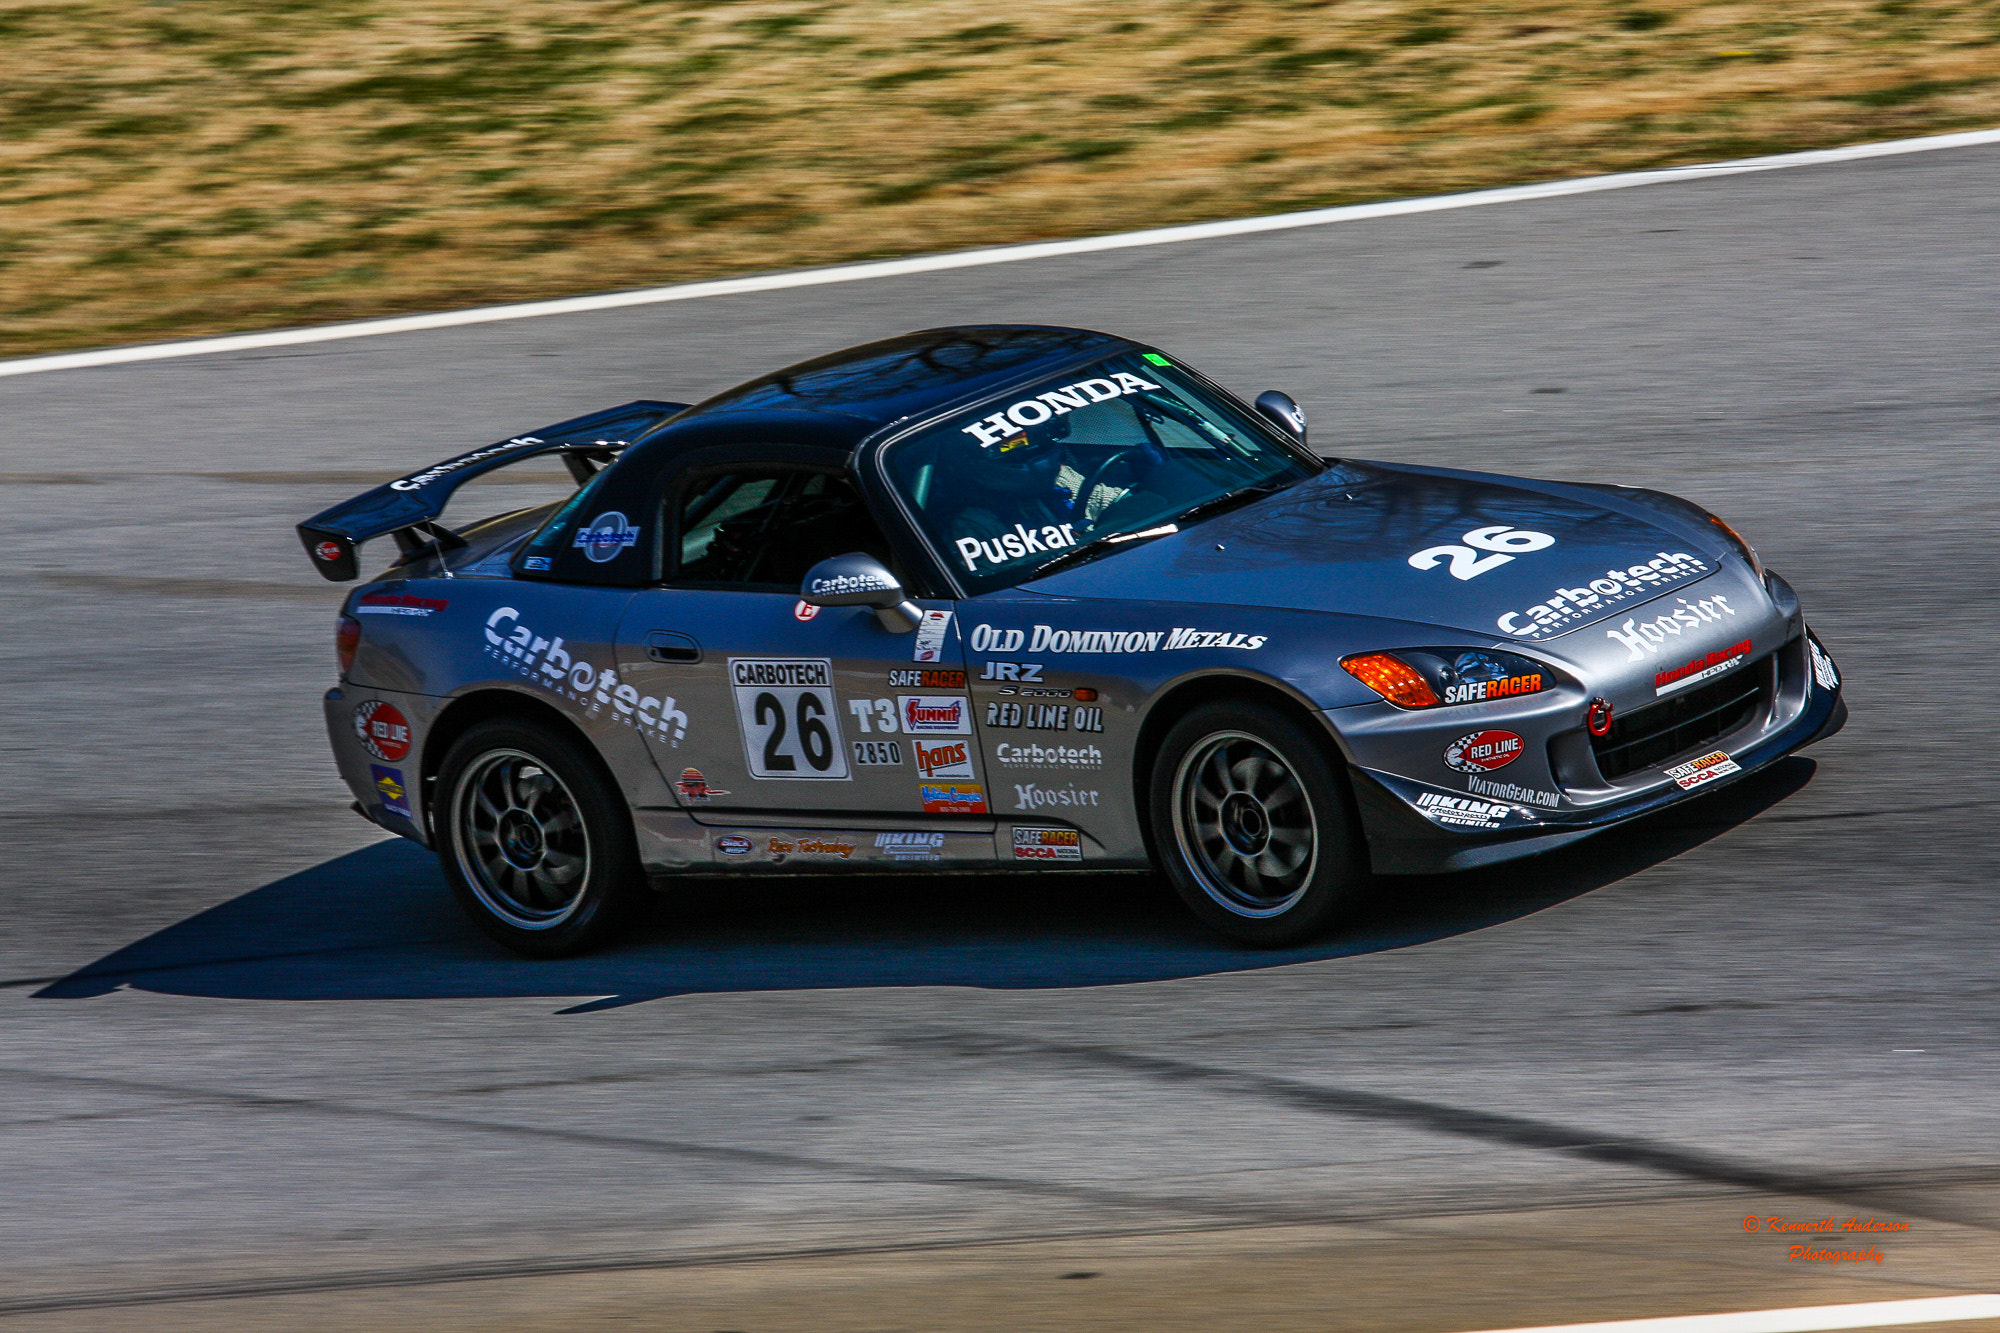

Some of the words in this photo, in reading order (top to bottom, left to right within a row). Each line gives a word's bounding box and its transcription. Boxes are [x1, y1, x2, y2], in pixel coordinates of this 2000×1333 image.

[962, 371, 1161, 448] HONDA
[955, 523, 1076, 572] Puskar
[1408, 525, 1555, 580] 26
[812, 574, 890, 593] Carbotec
[1496, 551, 1704, 635] Carbotech
[1532, 585, 1647, 639] PERFORMANCE
[1652, 565, 1708, 586] BRAKES
[970, 623, 1025, 652] OLD
[1028, 624, 1164, 653] DOMINION
[1607, 594, 1735, 663] Hoosier
[484, 606, 688, 740] Carbotech
[736, 664, 827, 684] CARBOTECH
[980, 661, 1043, 682] JRZ
[1655, 660, 1704, 686] Honda
[1705, 639, 1752, 667] Racing
[889, 668, 965, 688] SAFERACER
[1445, 673, 1542, 704] SAFERACER
[483, 644, 600, 713] PERFORMANCE
[612, 711, 679, 749] BRAKES
[848, 698, 899, 732] T3
[986, 702, 1021, 728] RED
[1027, 703, 1070, 731] LINE
[1074, 706, 1104, 733] OIL
[372, 720, 388, 739] RED
[391, 724, 408, 743] LINE
[755, 692, 833, 771] 26
[855, 742, 901, 763] 2850
[915, 741, 967, 777] hans
[997, 743, 1102, 765] Carbotech
[1471, 742, 1492, 759] RED
[1495, 737, 1520, 755] LINE
[1671, 752, 1728, 779] SAFERACER
[1679, 770, 1719, 787] SCCA
[1014, 782, 1099, 810] Hoosier
[1015, 830, 1078, 845] SAFERACER
[1440, 816, 1500, 829] UNLIMITED
[1015, 847, 1057, 858] SCCA
